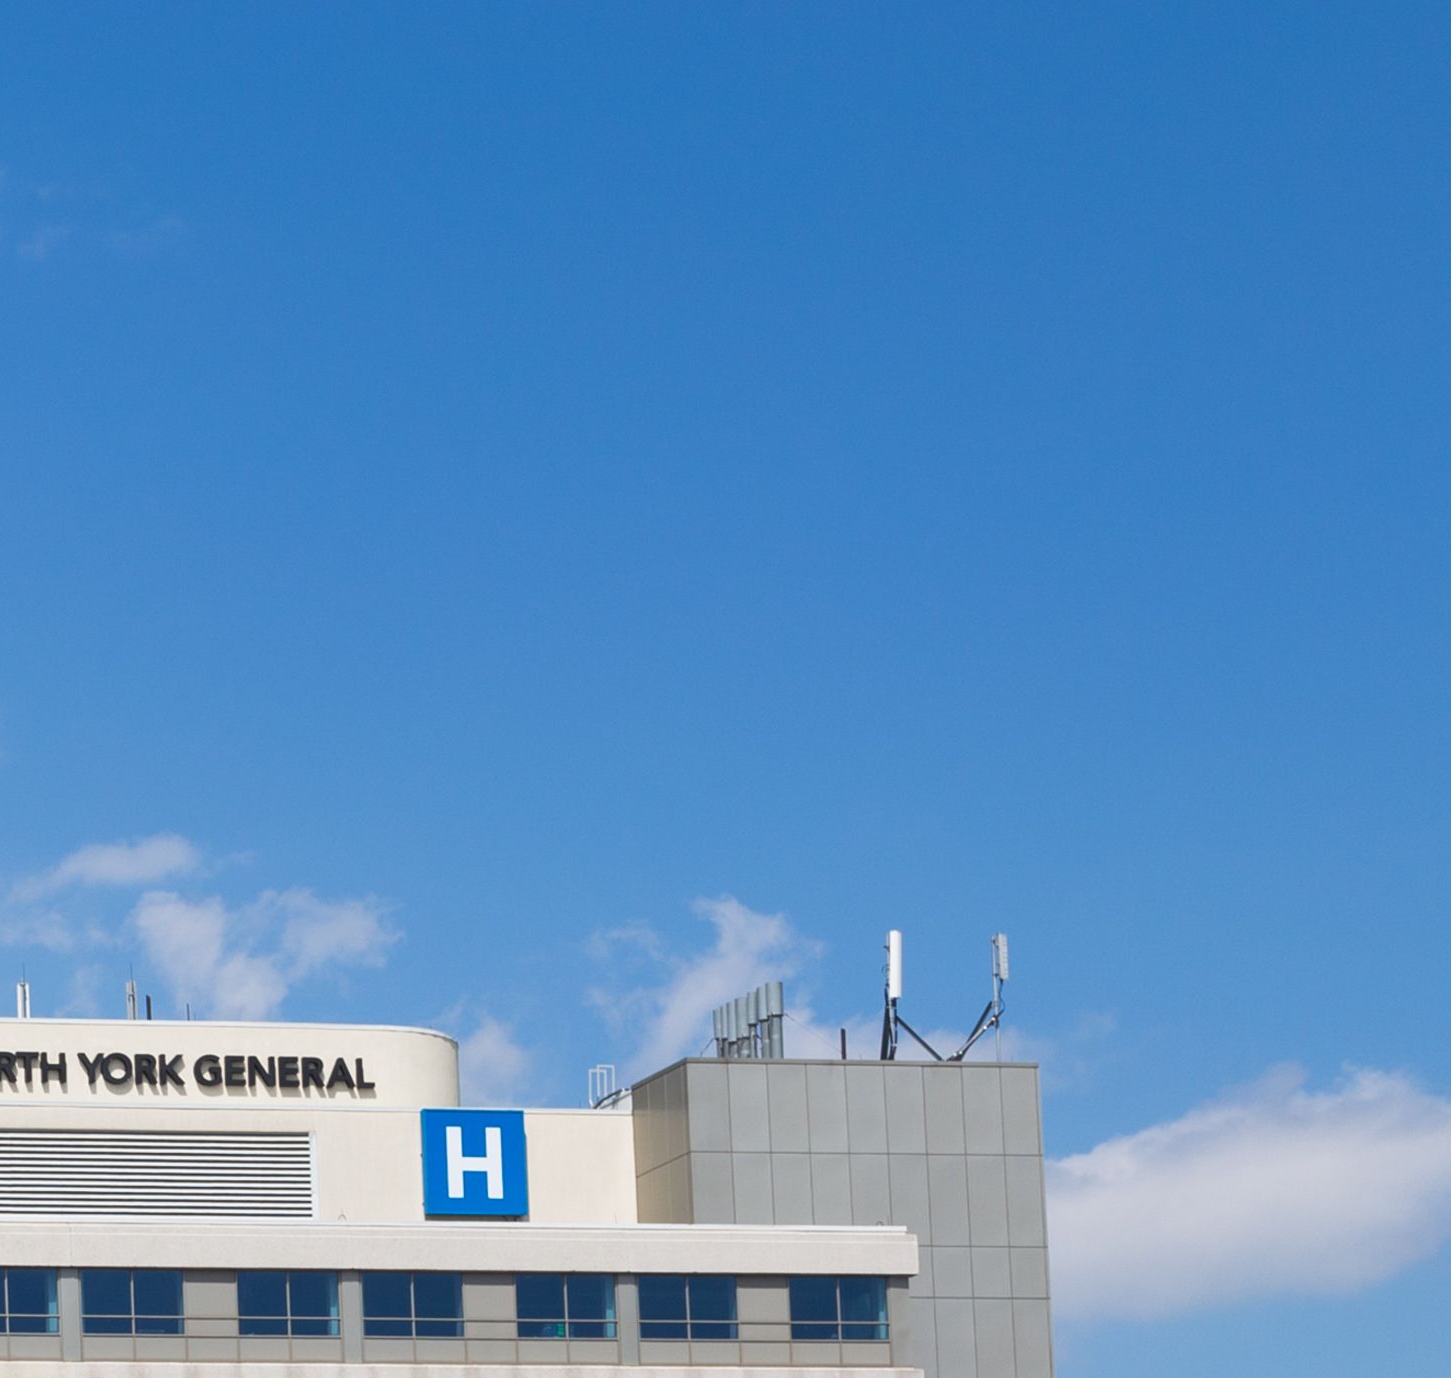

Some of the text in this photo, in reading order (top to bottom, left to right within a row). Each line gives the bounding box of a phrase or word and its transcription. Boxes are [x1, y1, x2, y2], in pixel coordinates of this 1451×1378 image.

[76, 1052, 185, 1086] YORK
[193, 1053, 376, 1090] GENERAL
[445, 1125, 504, 1200] H
